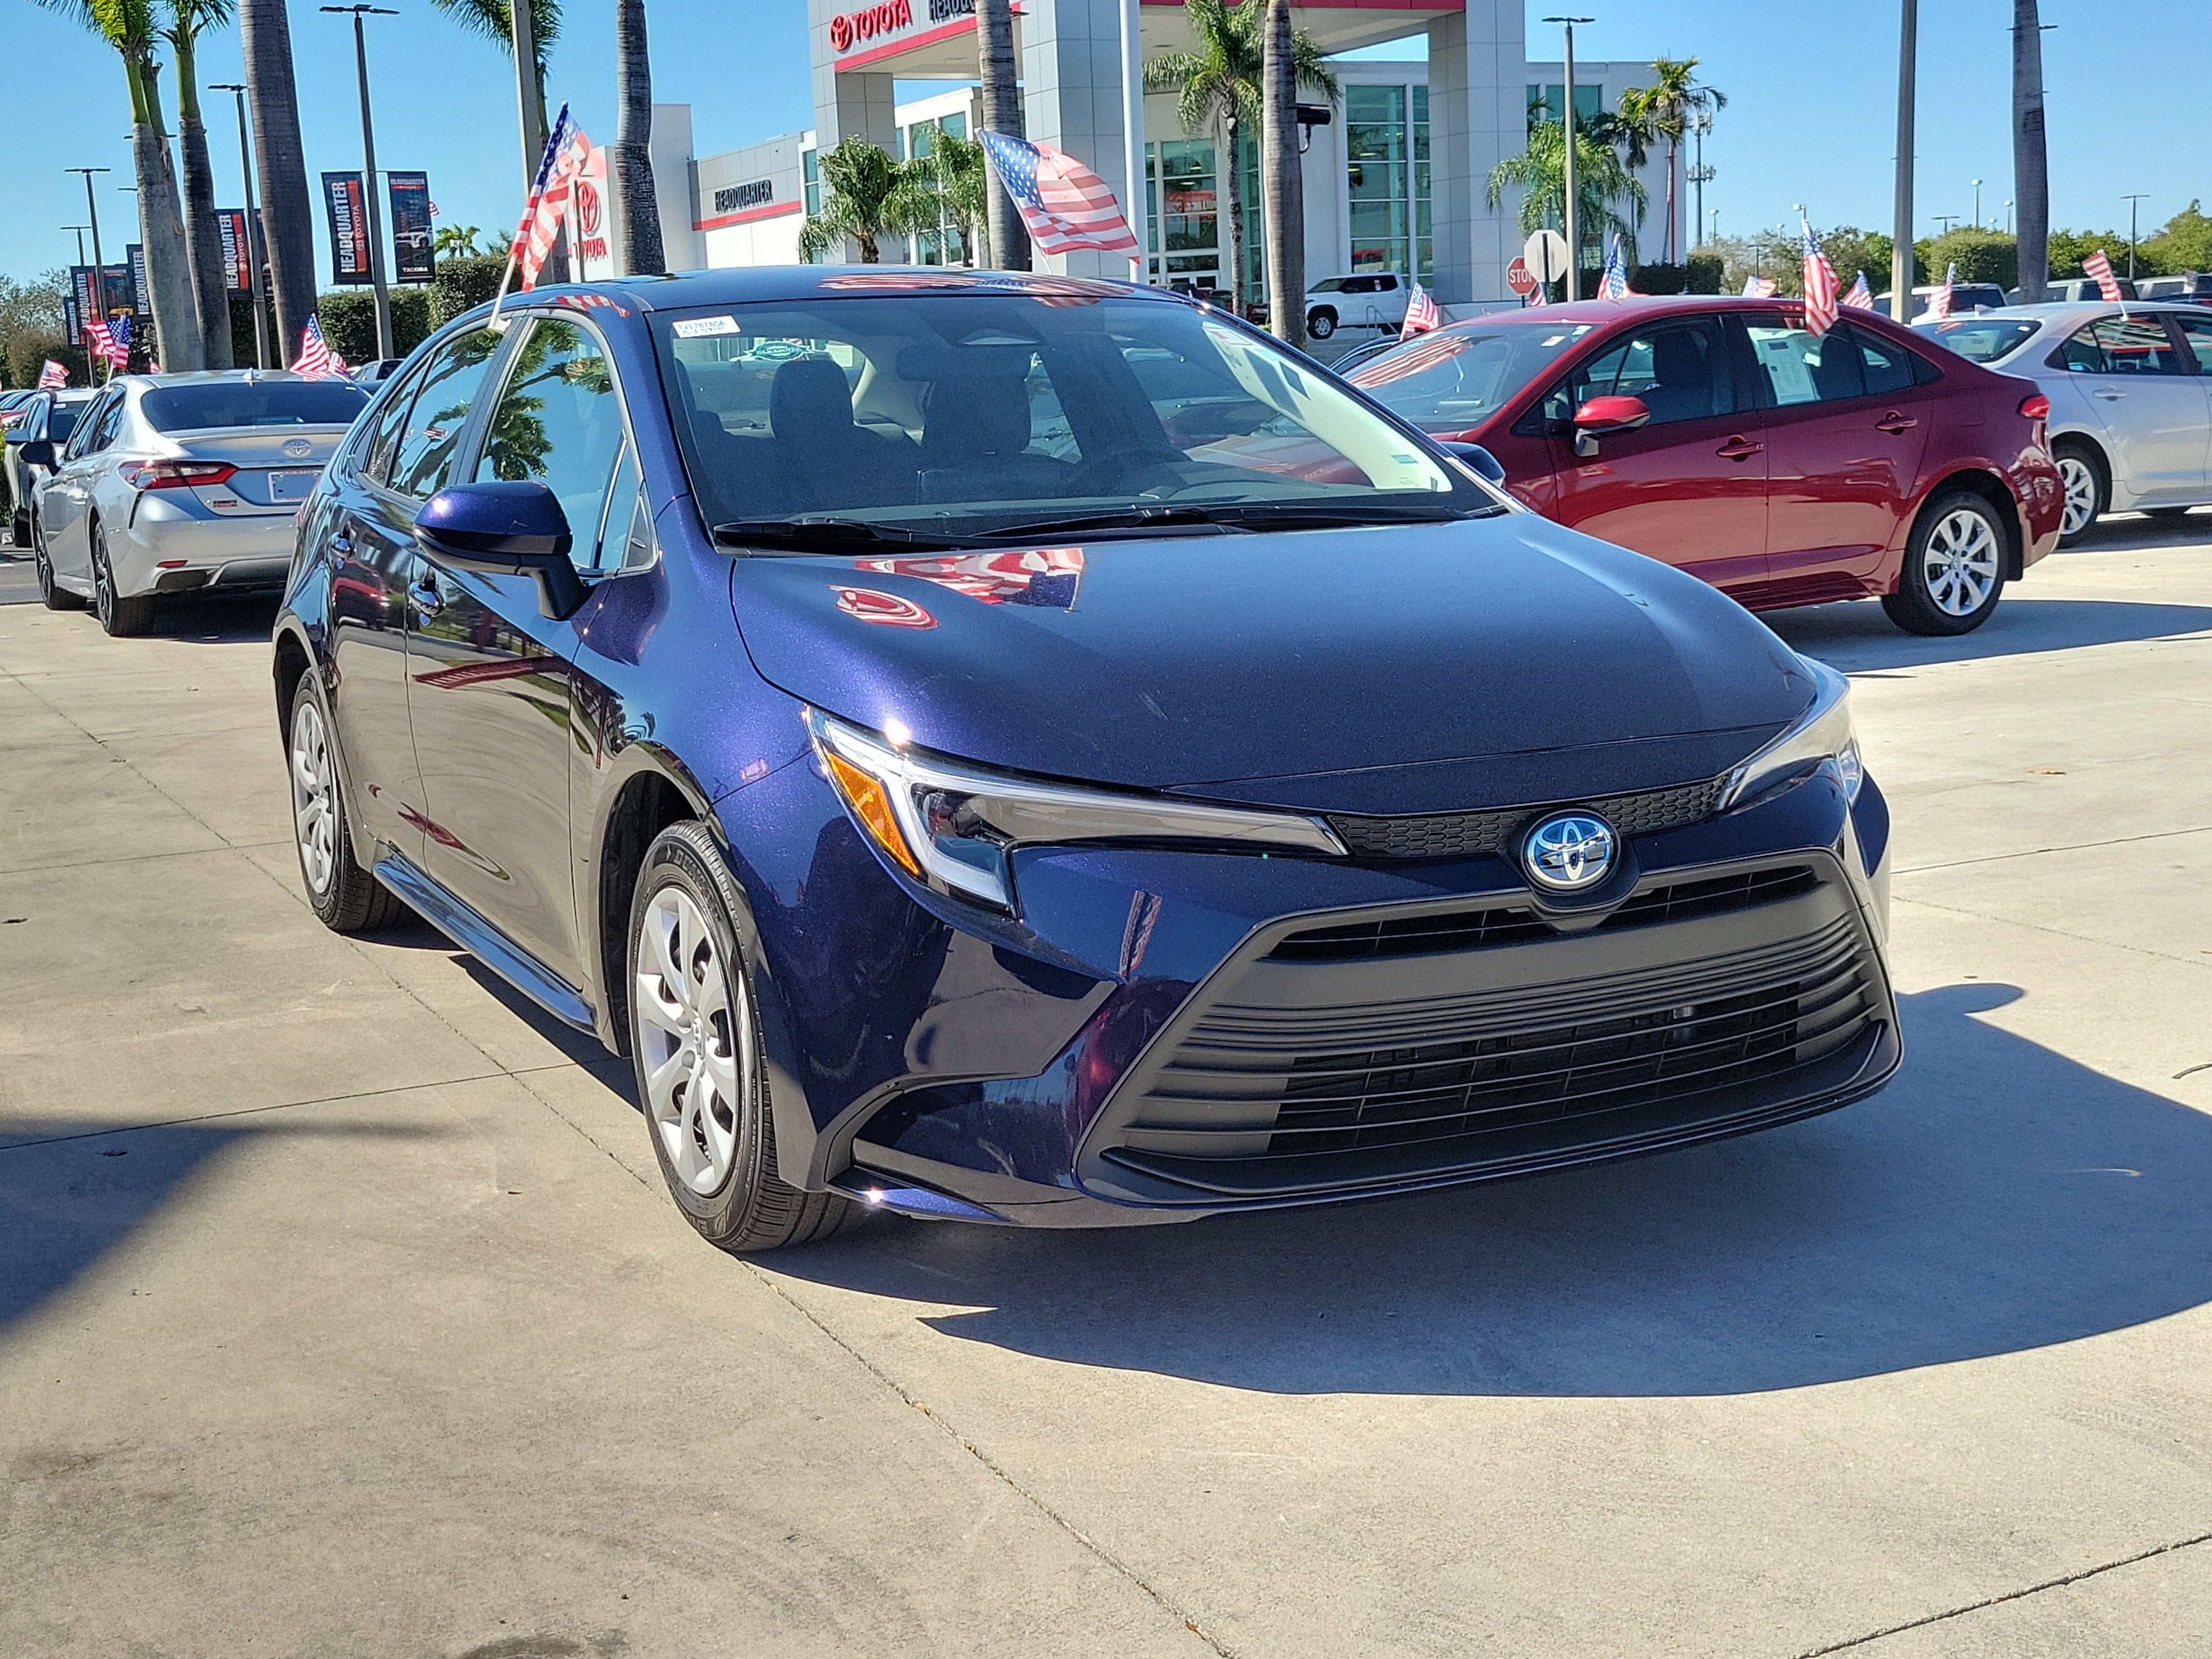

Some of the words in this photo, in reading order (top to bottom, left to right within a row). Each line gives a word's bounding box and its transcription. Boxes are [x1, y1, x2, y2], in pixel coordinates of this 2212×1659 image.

[853, 0, 912, 40] TOYOTA
[715, 179, 773, 212] HEADQUARTER
[331, 182, 356, 273] HEADQUARTER
[352, 205, 365, 239] TOYOTA
[219, 215, 239, 289] HEADQUARTER
[236, 233, 246, 262] TOYOTA
[573, 237, 607, 259] TYOTA
[133, 251, 150, 315] HEADQUARTER
